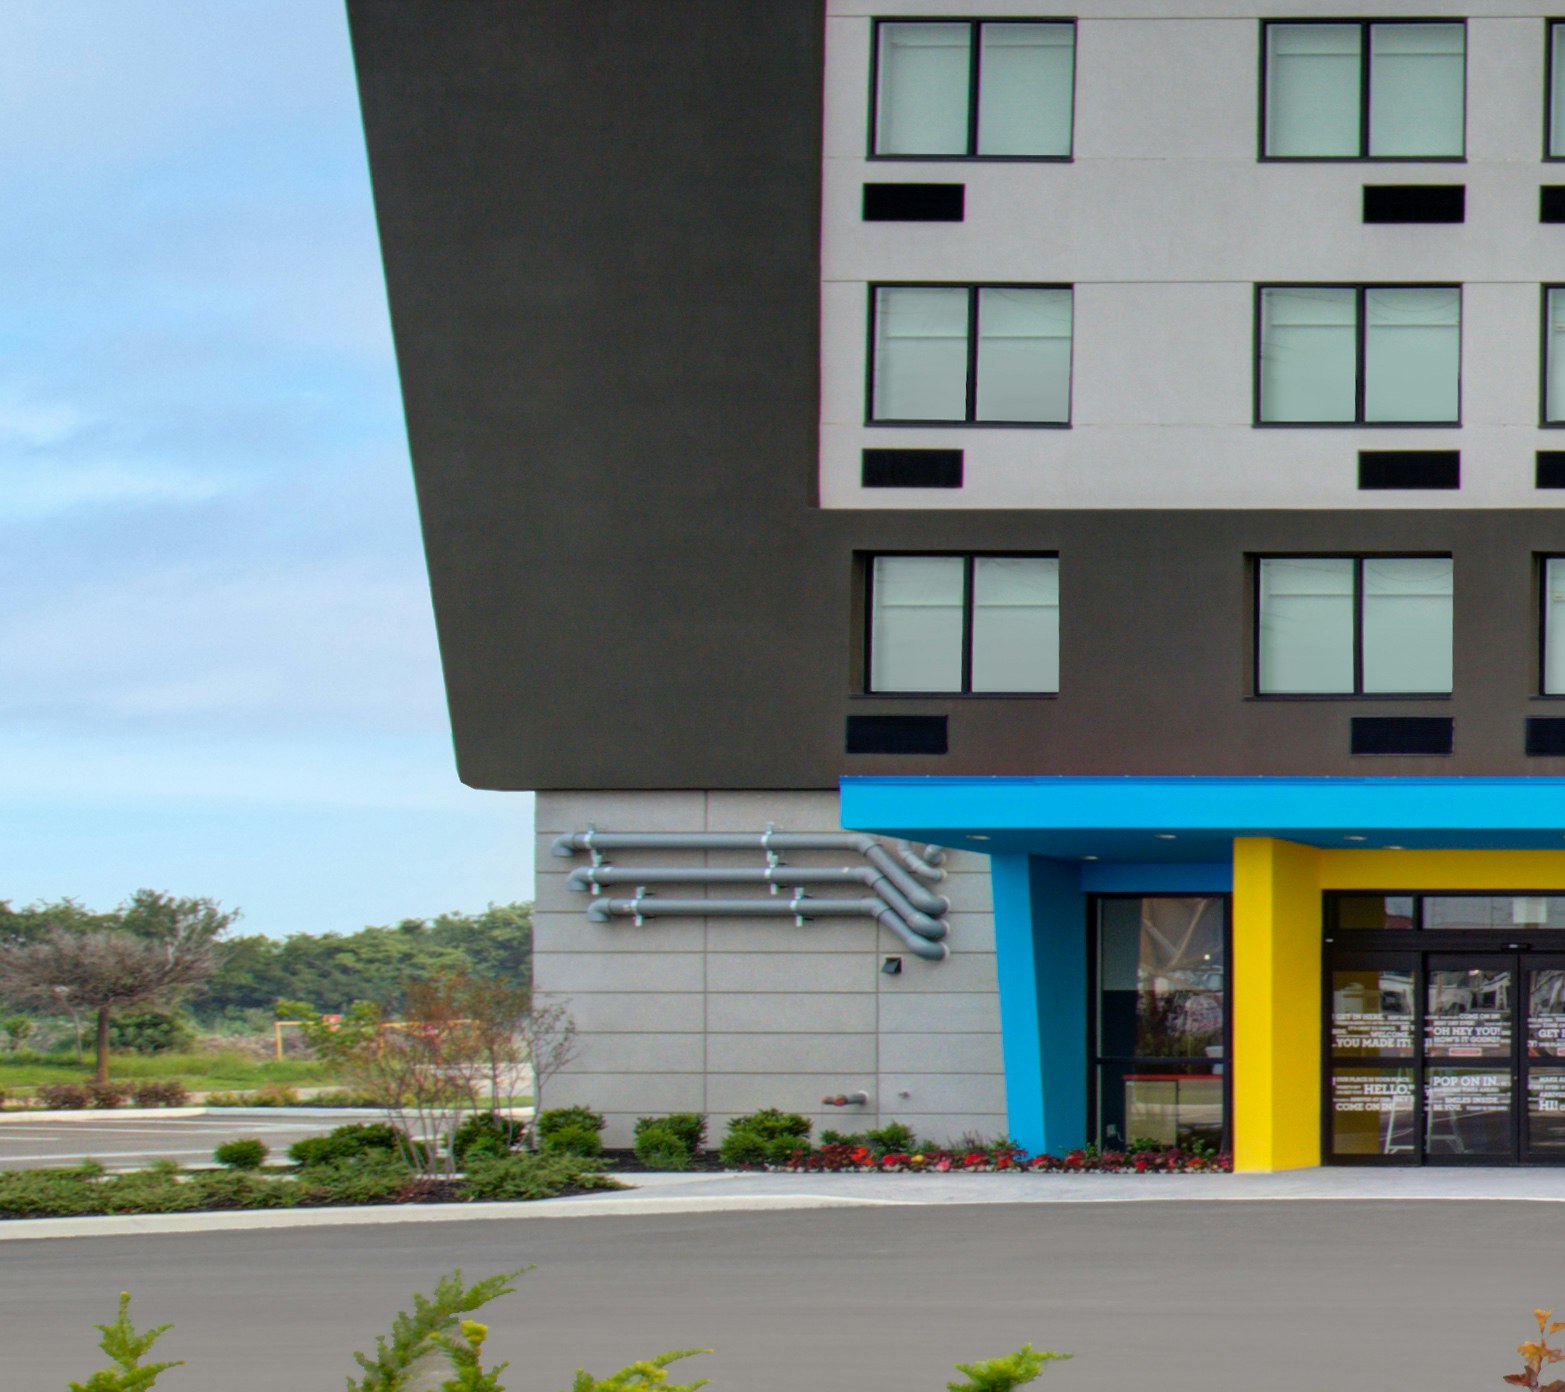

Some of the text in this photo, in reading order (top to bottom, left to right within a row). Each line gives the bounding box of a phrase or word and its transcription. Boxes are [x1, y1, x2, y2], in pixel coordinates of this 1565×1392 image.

[1433, 1027, 1450, 1036] OH
[1452, 1027, 1474, 1036] HEY
[1475, 1027, 1501, 1036] YOU!
[1538, 1029, 1560, 1038] GET
[1336, 1038, 1411, 1047] YOU MADE IT!
[1432, 1076, 1458, 1086] POP
[1460, 1076, 1480, 1086] ON
